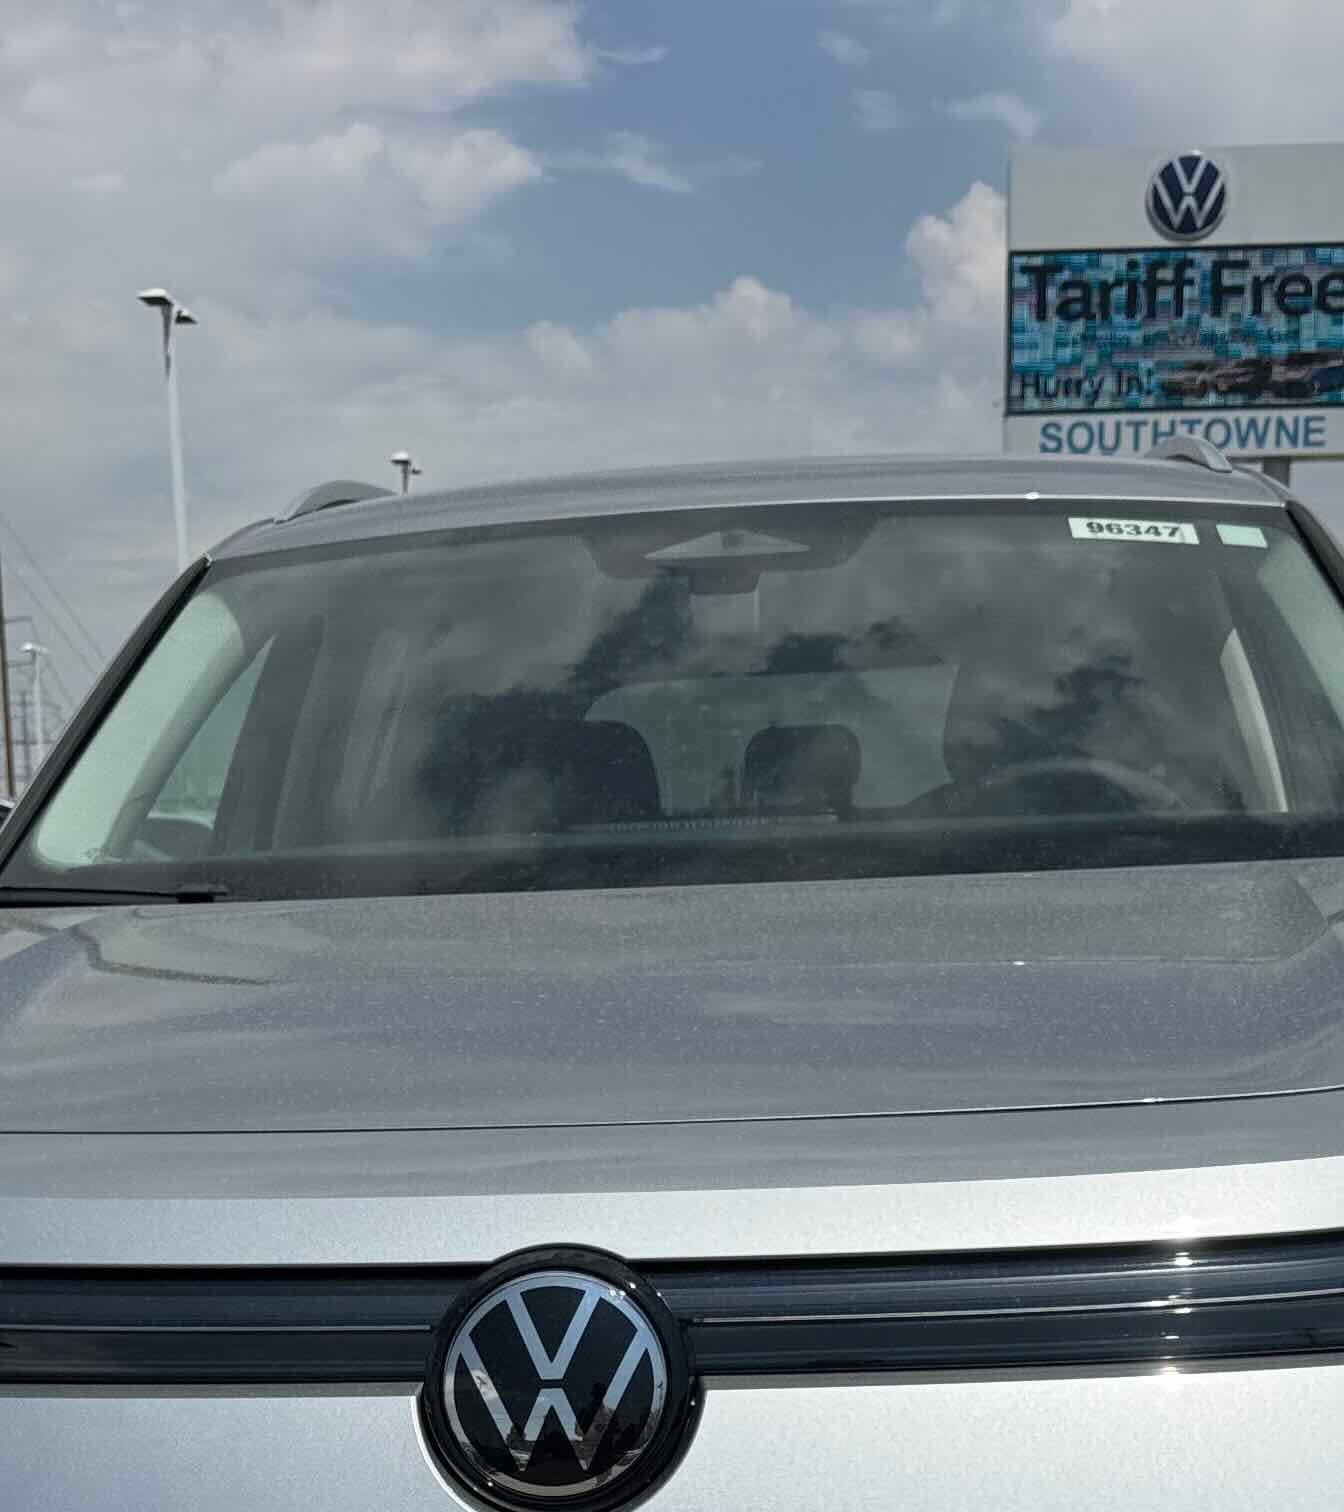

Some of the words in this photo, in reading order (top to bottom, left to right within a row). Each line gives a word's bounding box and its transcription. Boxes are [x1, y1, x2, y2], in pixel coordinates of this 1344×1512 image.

[1020, 257, 1194, 322] Tariff
[1020, 371, 1104, 401] Hurry
[1086, 521, 1180, 537] 96347
[443, 1271, 669, 1494] VW
